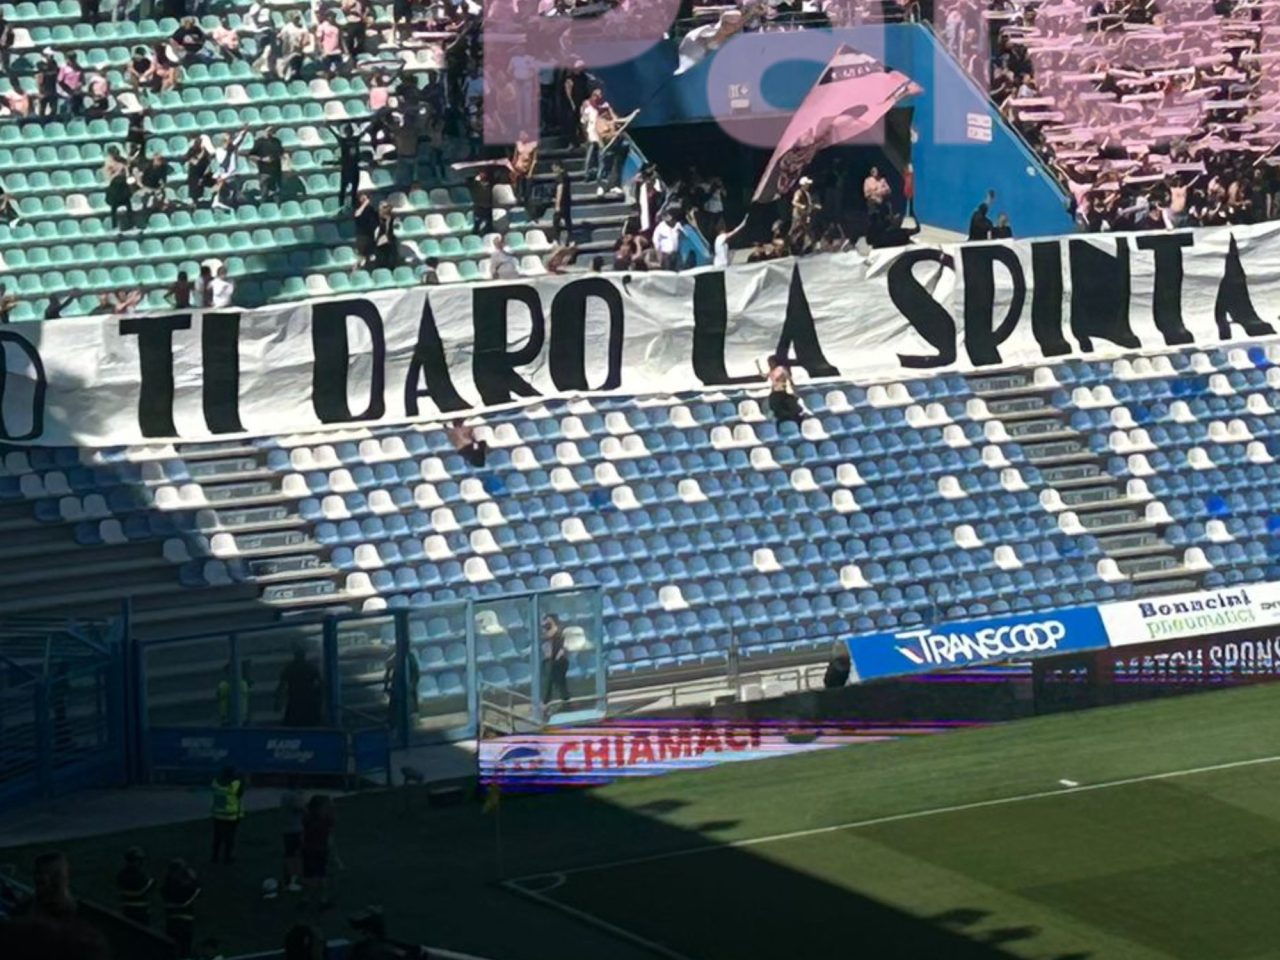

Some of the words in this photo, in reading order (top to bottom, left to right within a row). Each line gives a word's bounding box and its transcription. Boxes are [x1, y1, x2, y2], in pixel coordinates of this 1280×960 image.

[119, 313, 248, 438] TI
[692, 262, 840, 386] LA
[894, 620, 1066, 665] TRANSCOOP
